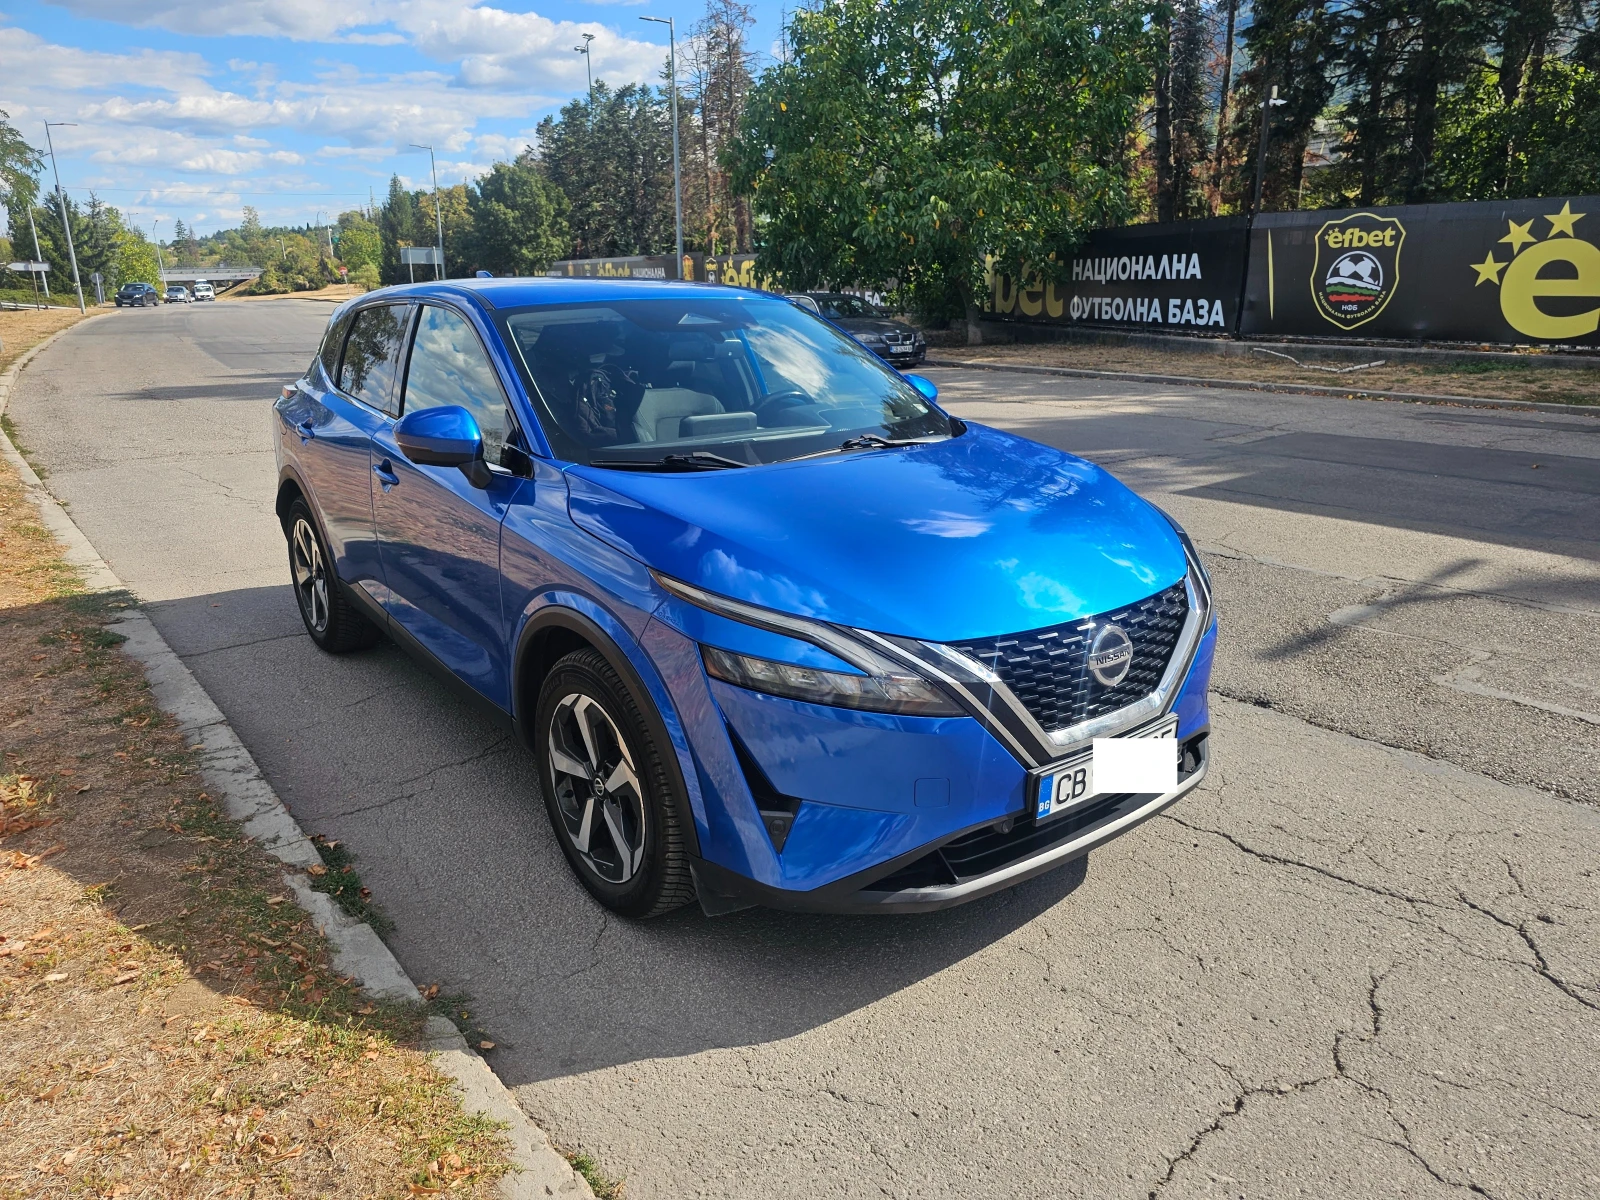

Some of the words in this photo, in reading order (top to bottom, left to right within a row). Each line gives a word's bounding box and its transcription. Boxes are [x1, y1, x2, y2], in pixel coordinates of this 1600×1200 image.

[1327, 226, 1396, 249] efbet
[1072, 252, 1202, 285] НАЦИОНАЛНА
[1070, 295, 1163, 324] ФУТБОЛНА
[1168, 298, 1225, 327] БАЗА
[1096, 650, 1130, 666] NISSAN
[1056, 767, 1087, 805] CB
[1038, 800, 1050, 812] BG
